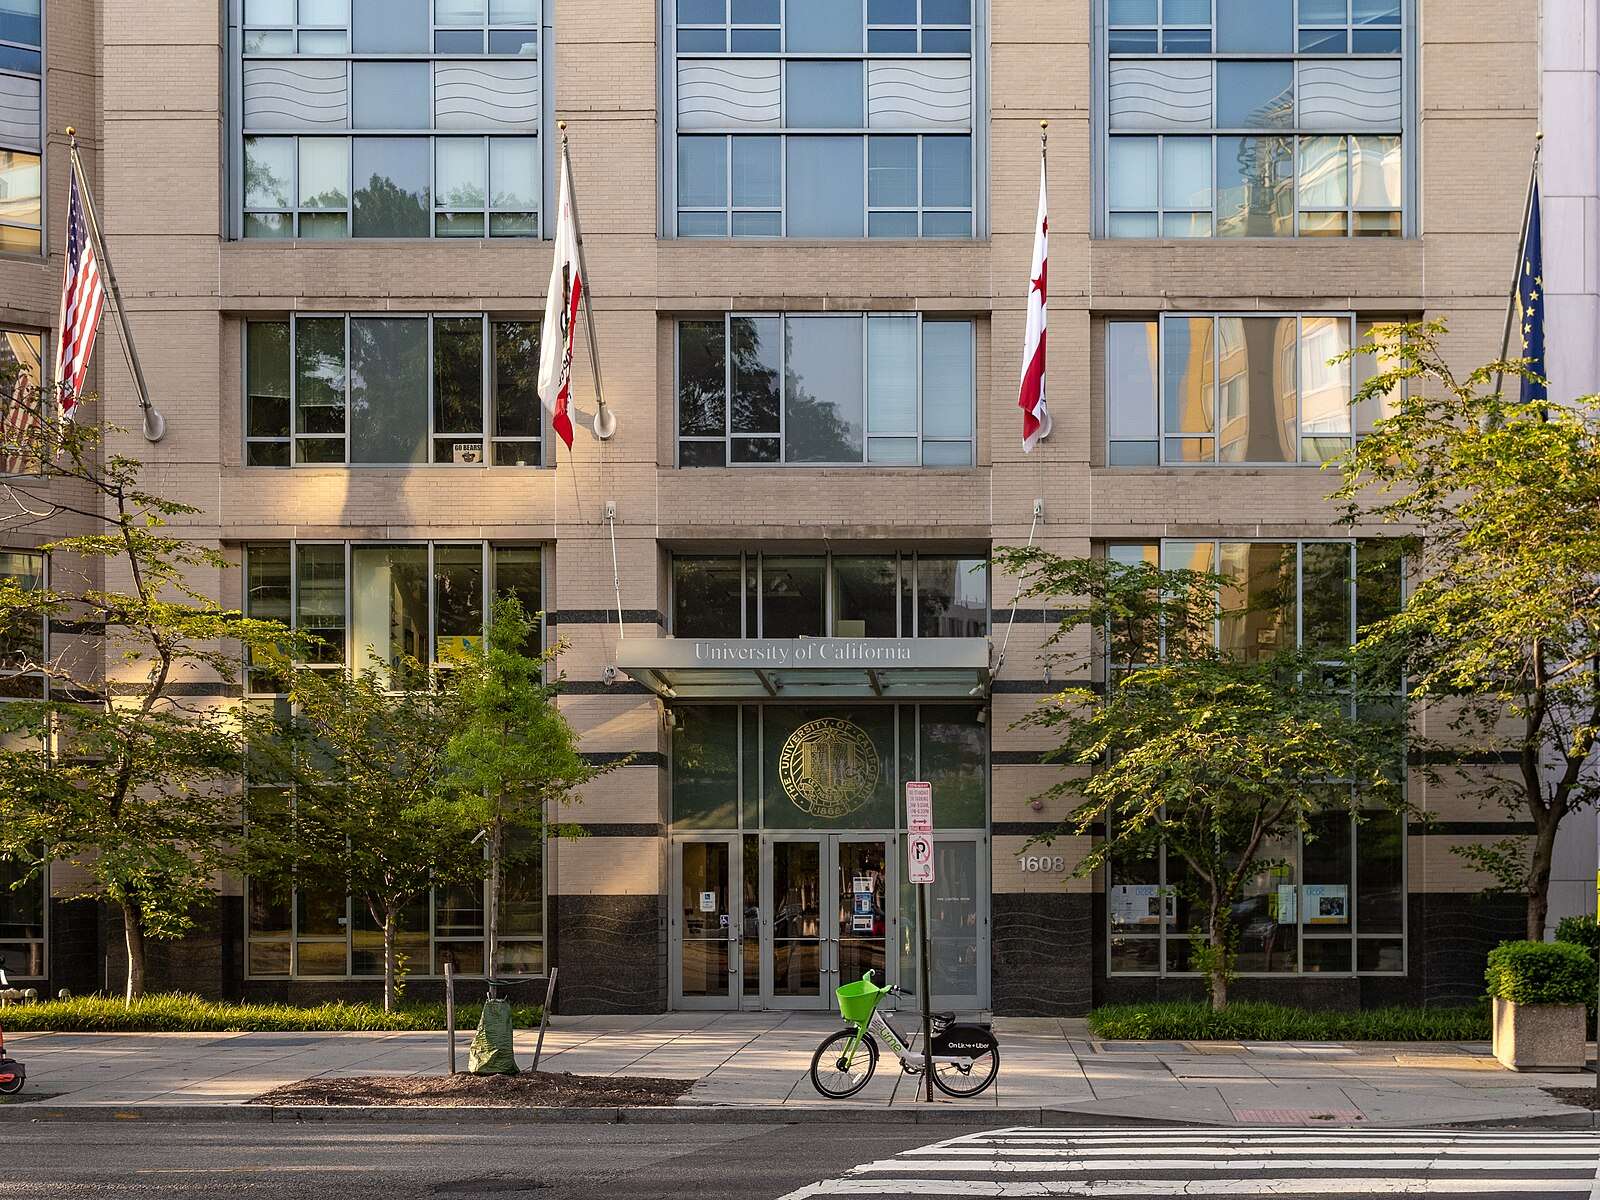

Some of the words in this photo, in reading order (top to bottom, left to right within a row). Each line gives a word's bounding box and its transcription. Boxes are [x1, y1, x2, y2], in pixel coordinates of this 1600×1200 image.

[695, 643, 789, 664] University
[795, 643, 816, 660] of
[819, 643, 911, 660] California
[836, 721, 853, 731] OF
[782, 720, 829, 769] UNIVERSITY
[783, 777, 799, 800] THE
[1018, 856, 1065, 872] 1608
